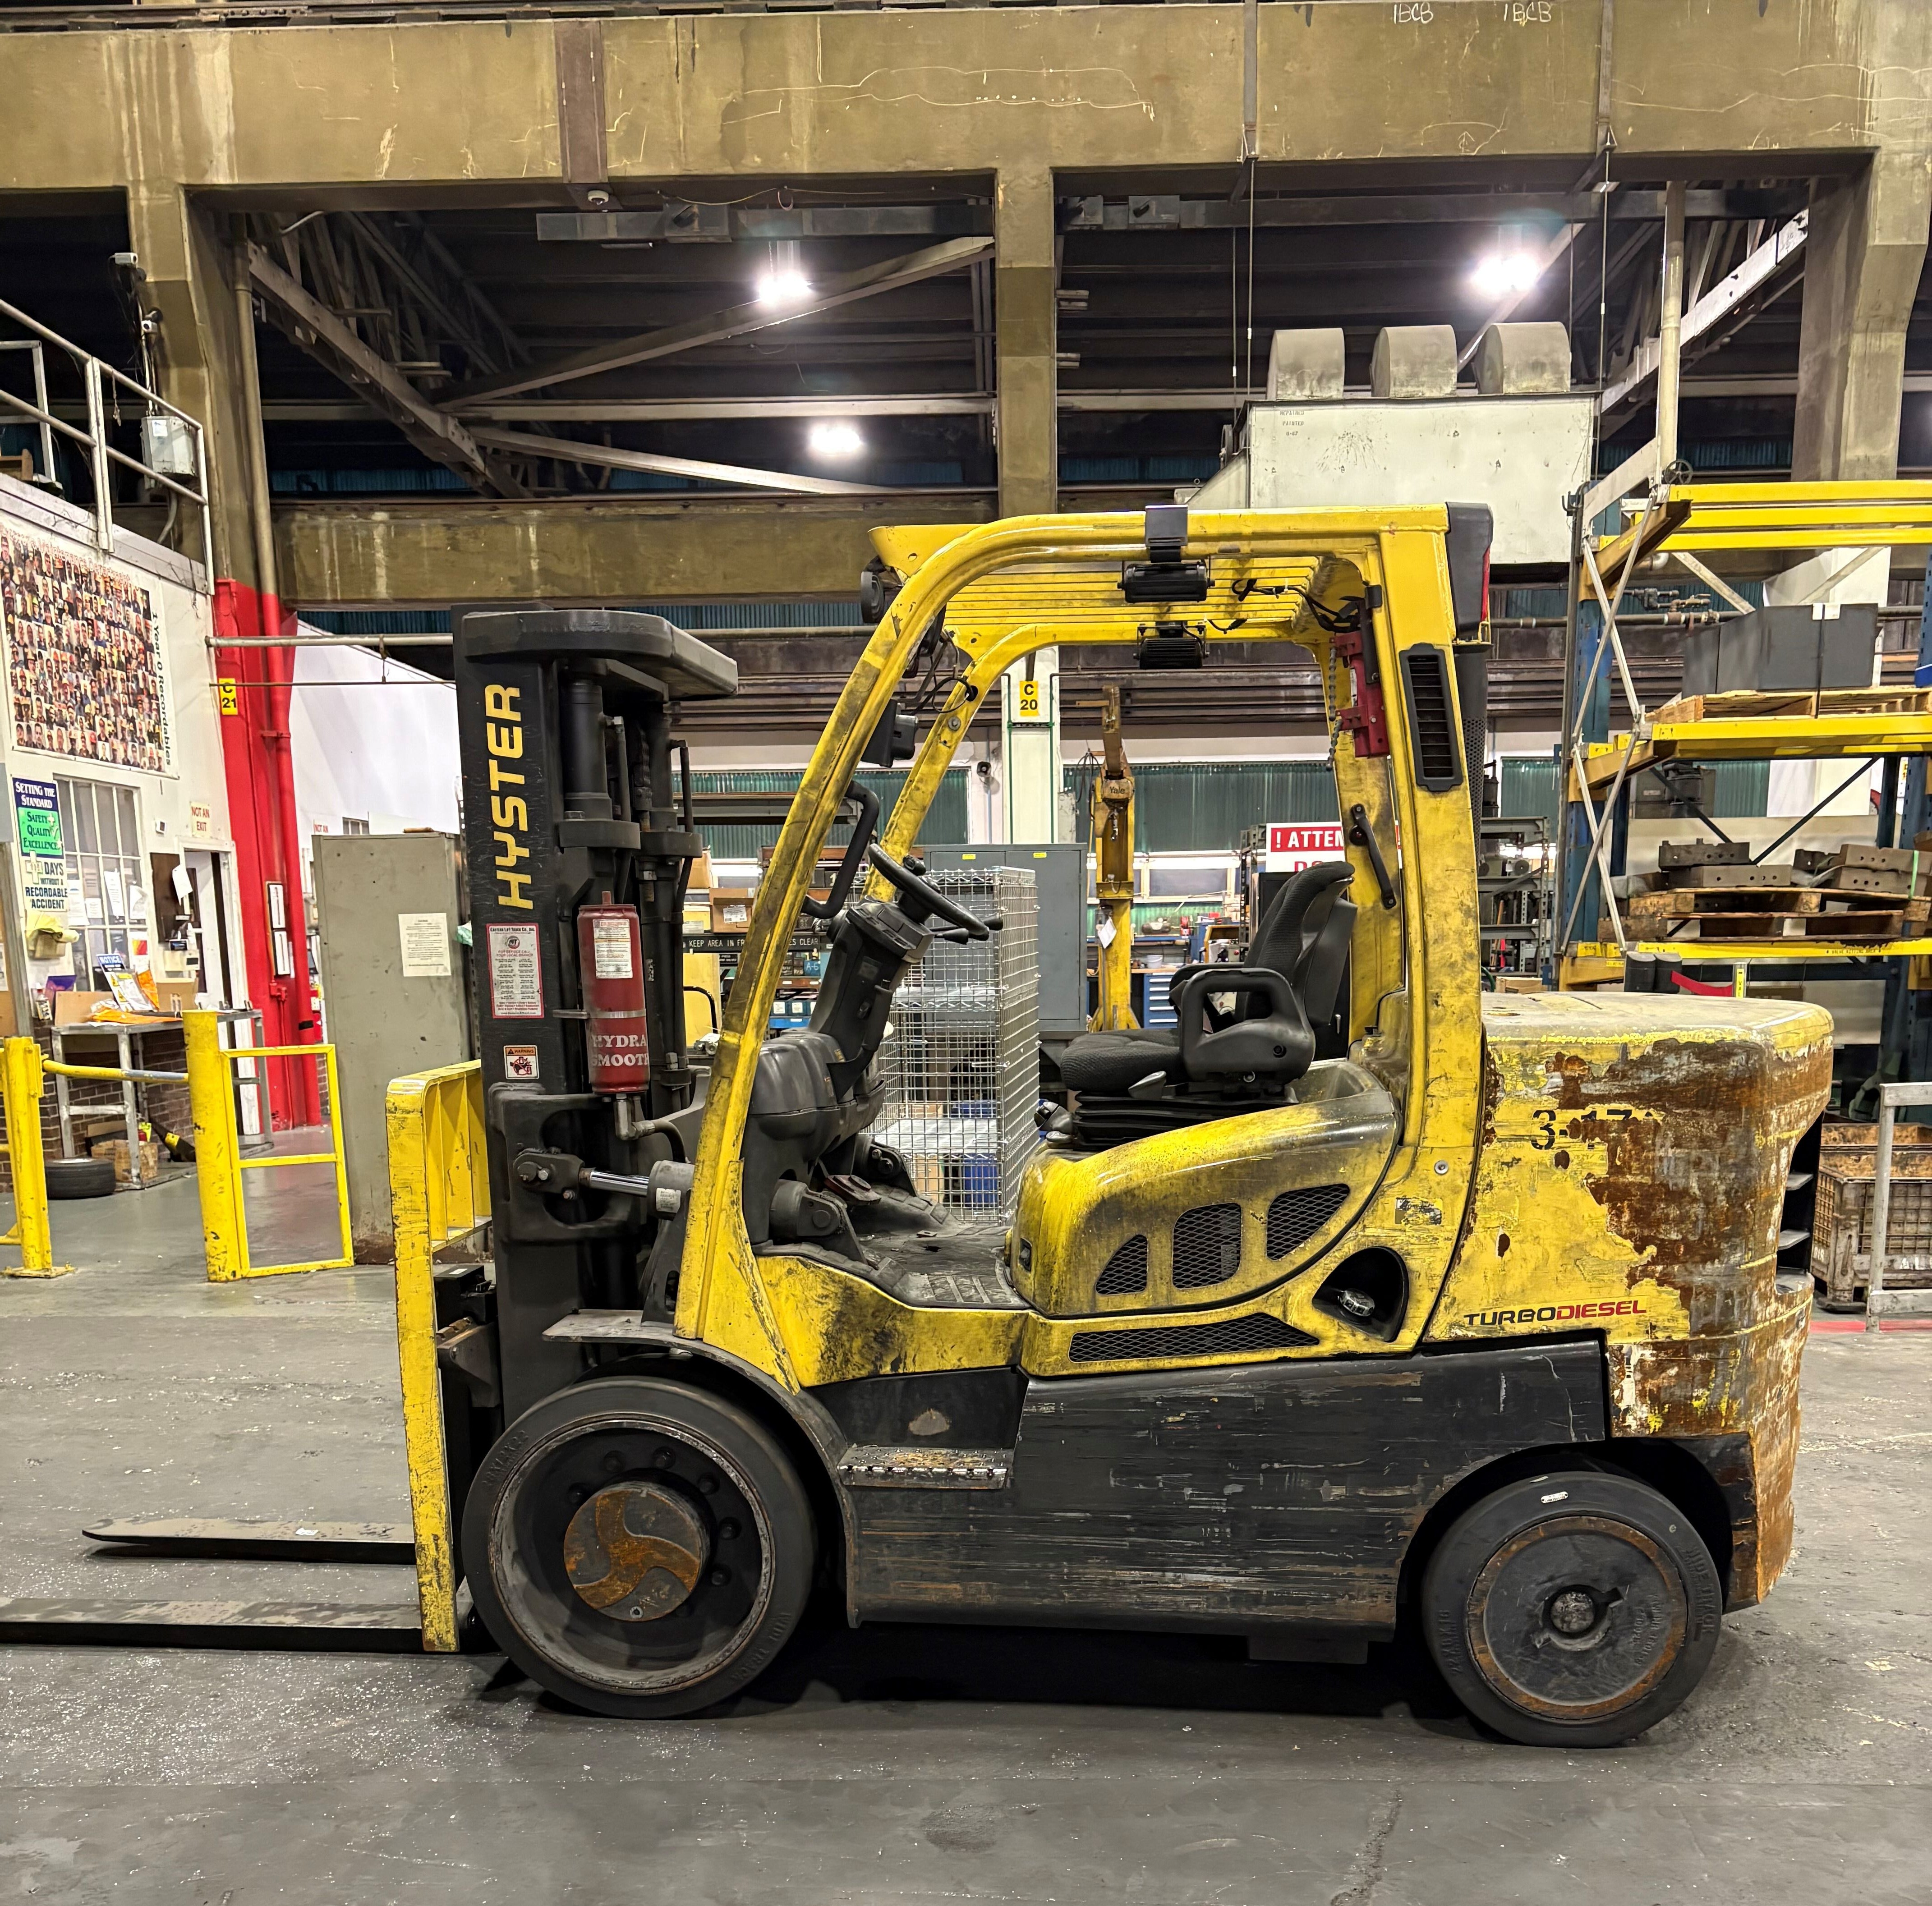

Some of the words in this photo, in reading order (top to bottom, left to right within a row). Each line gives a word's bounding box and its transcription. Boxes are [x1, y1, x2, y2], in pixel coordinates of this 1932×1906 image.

[1024, 684, 1034, 696] C
[222, 698, 236, 708] 21
[1021, 699, 1038, 711] 20
[158, 675, 171, 766] Recordables
[485, 684, 533, 909] HYSTER
[191, 806, 201, 817] NOT
[197, 821, 207, 831] EXIT
[44, 862, 64, 876] DAYS
[25, 887, 68, 898] RECORDABLE
[31, 899, 64, 909] ACCIDENT
[591, 1034, 647, 1047] HYDRA
[1463, 1300, 1647, 1326] TURBODIESEL
